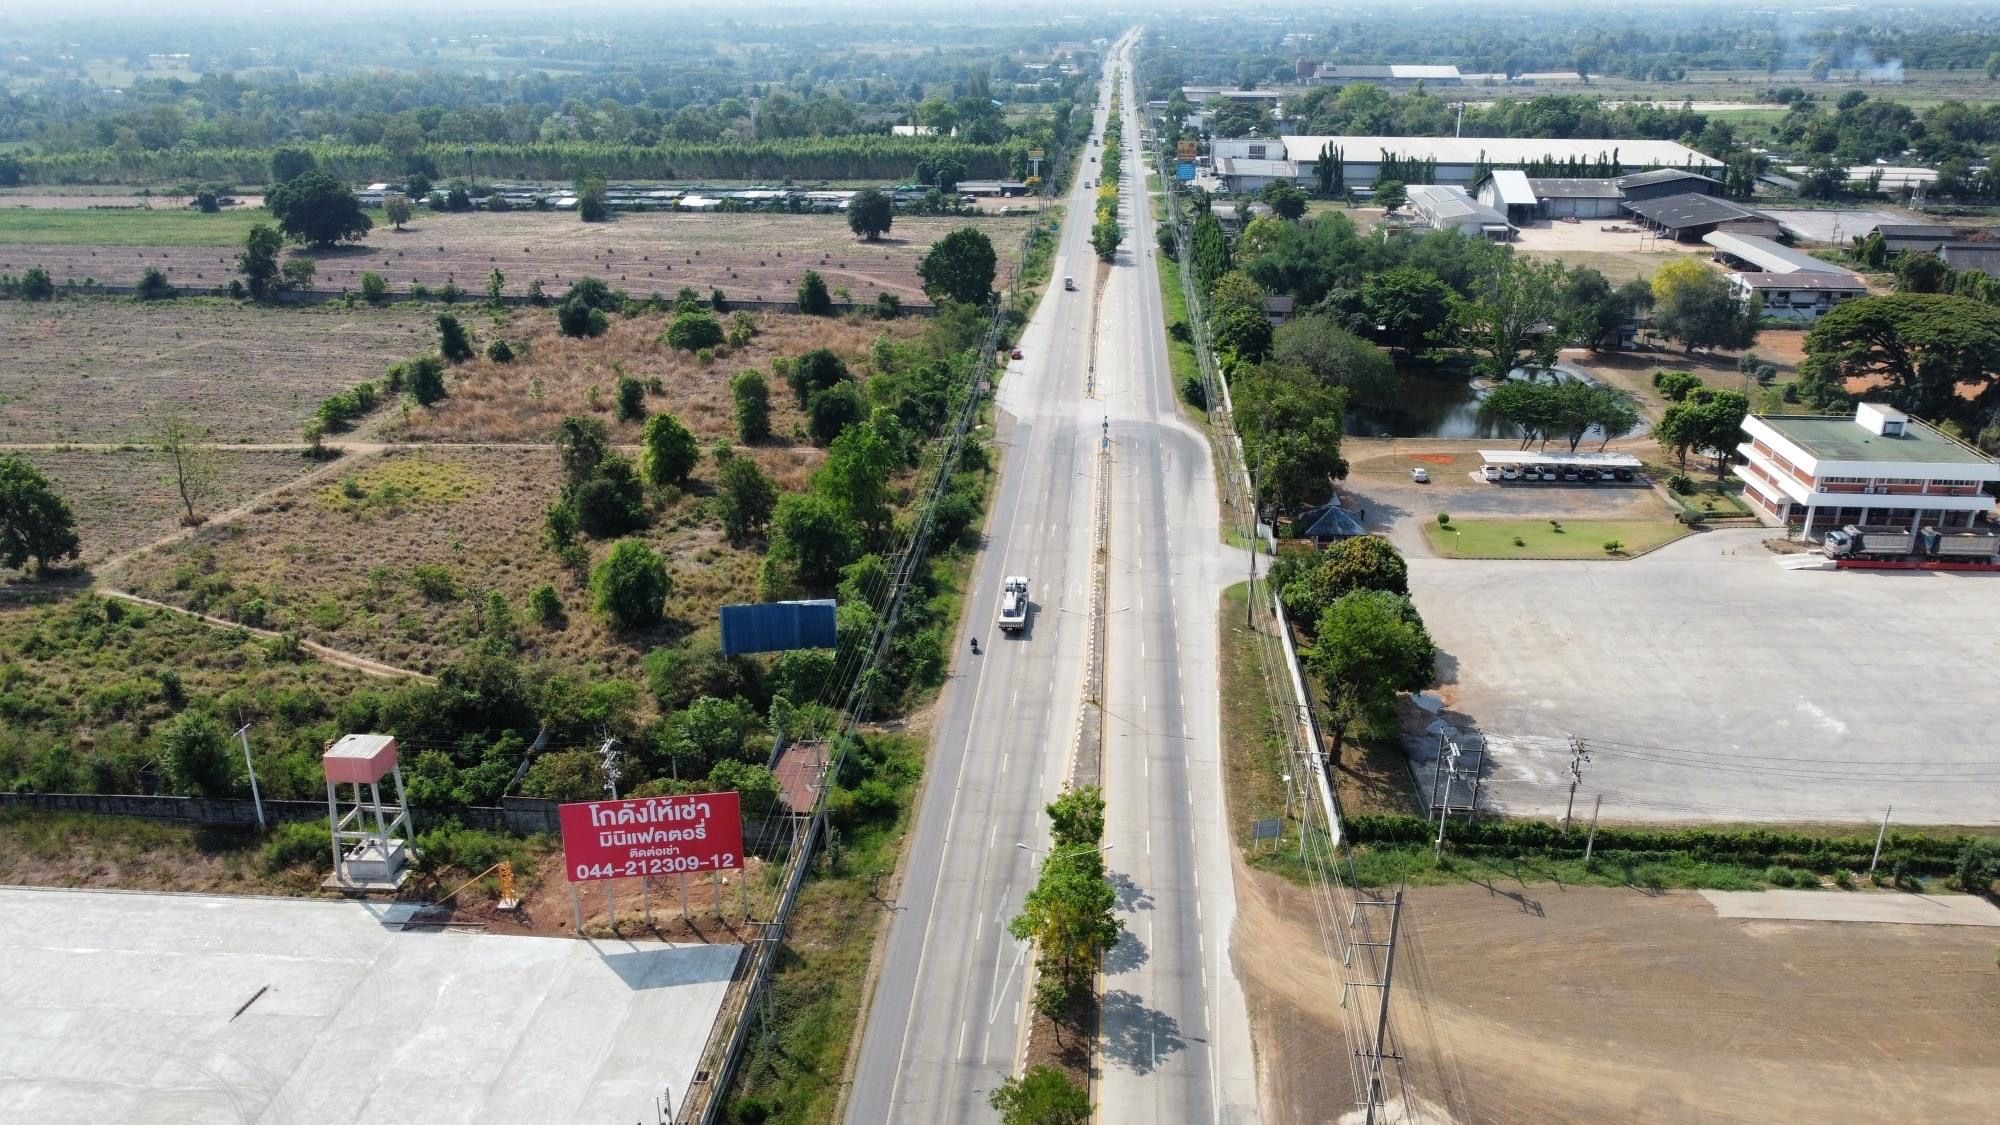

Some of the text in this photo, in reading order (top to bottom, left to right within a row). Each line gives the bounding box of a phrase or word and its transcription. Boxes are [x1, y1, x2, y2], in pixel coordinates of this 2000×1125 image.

[589, 798, 710, 827] โกดังให้เช่า
[599, 818, 706, 847] มินิแฟคตอรี่
[629, 845, 680, 858] ติดต่อเช่า
[576, 853, 734, 879] 044-212309-12
